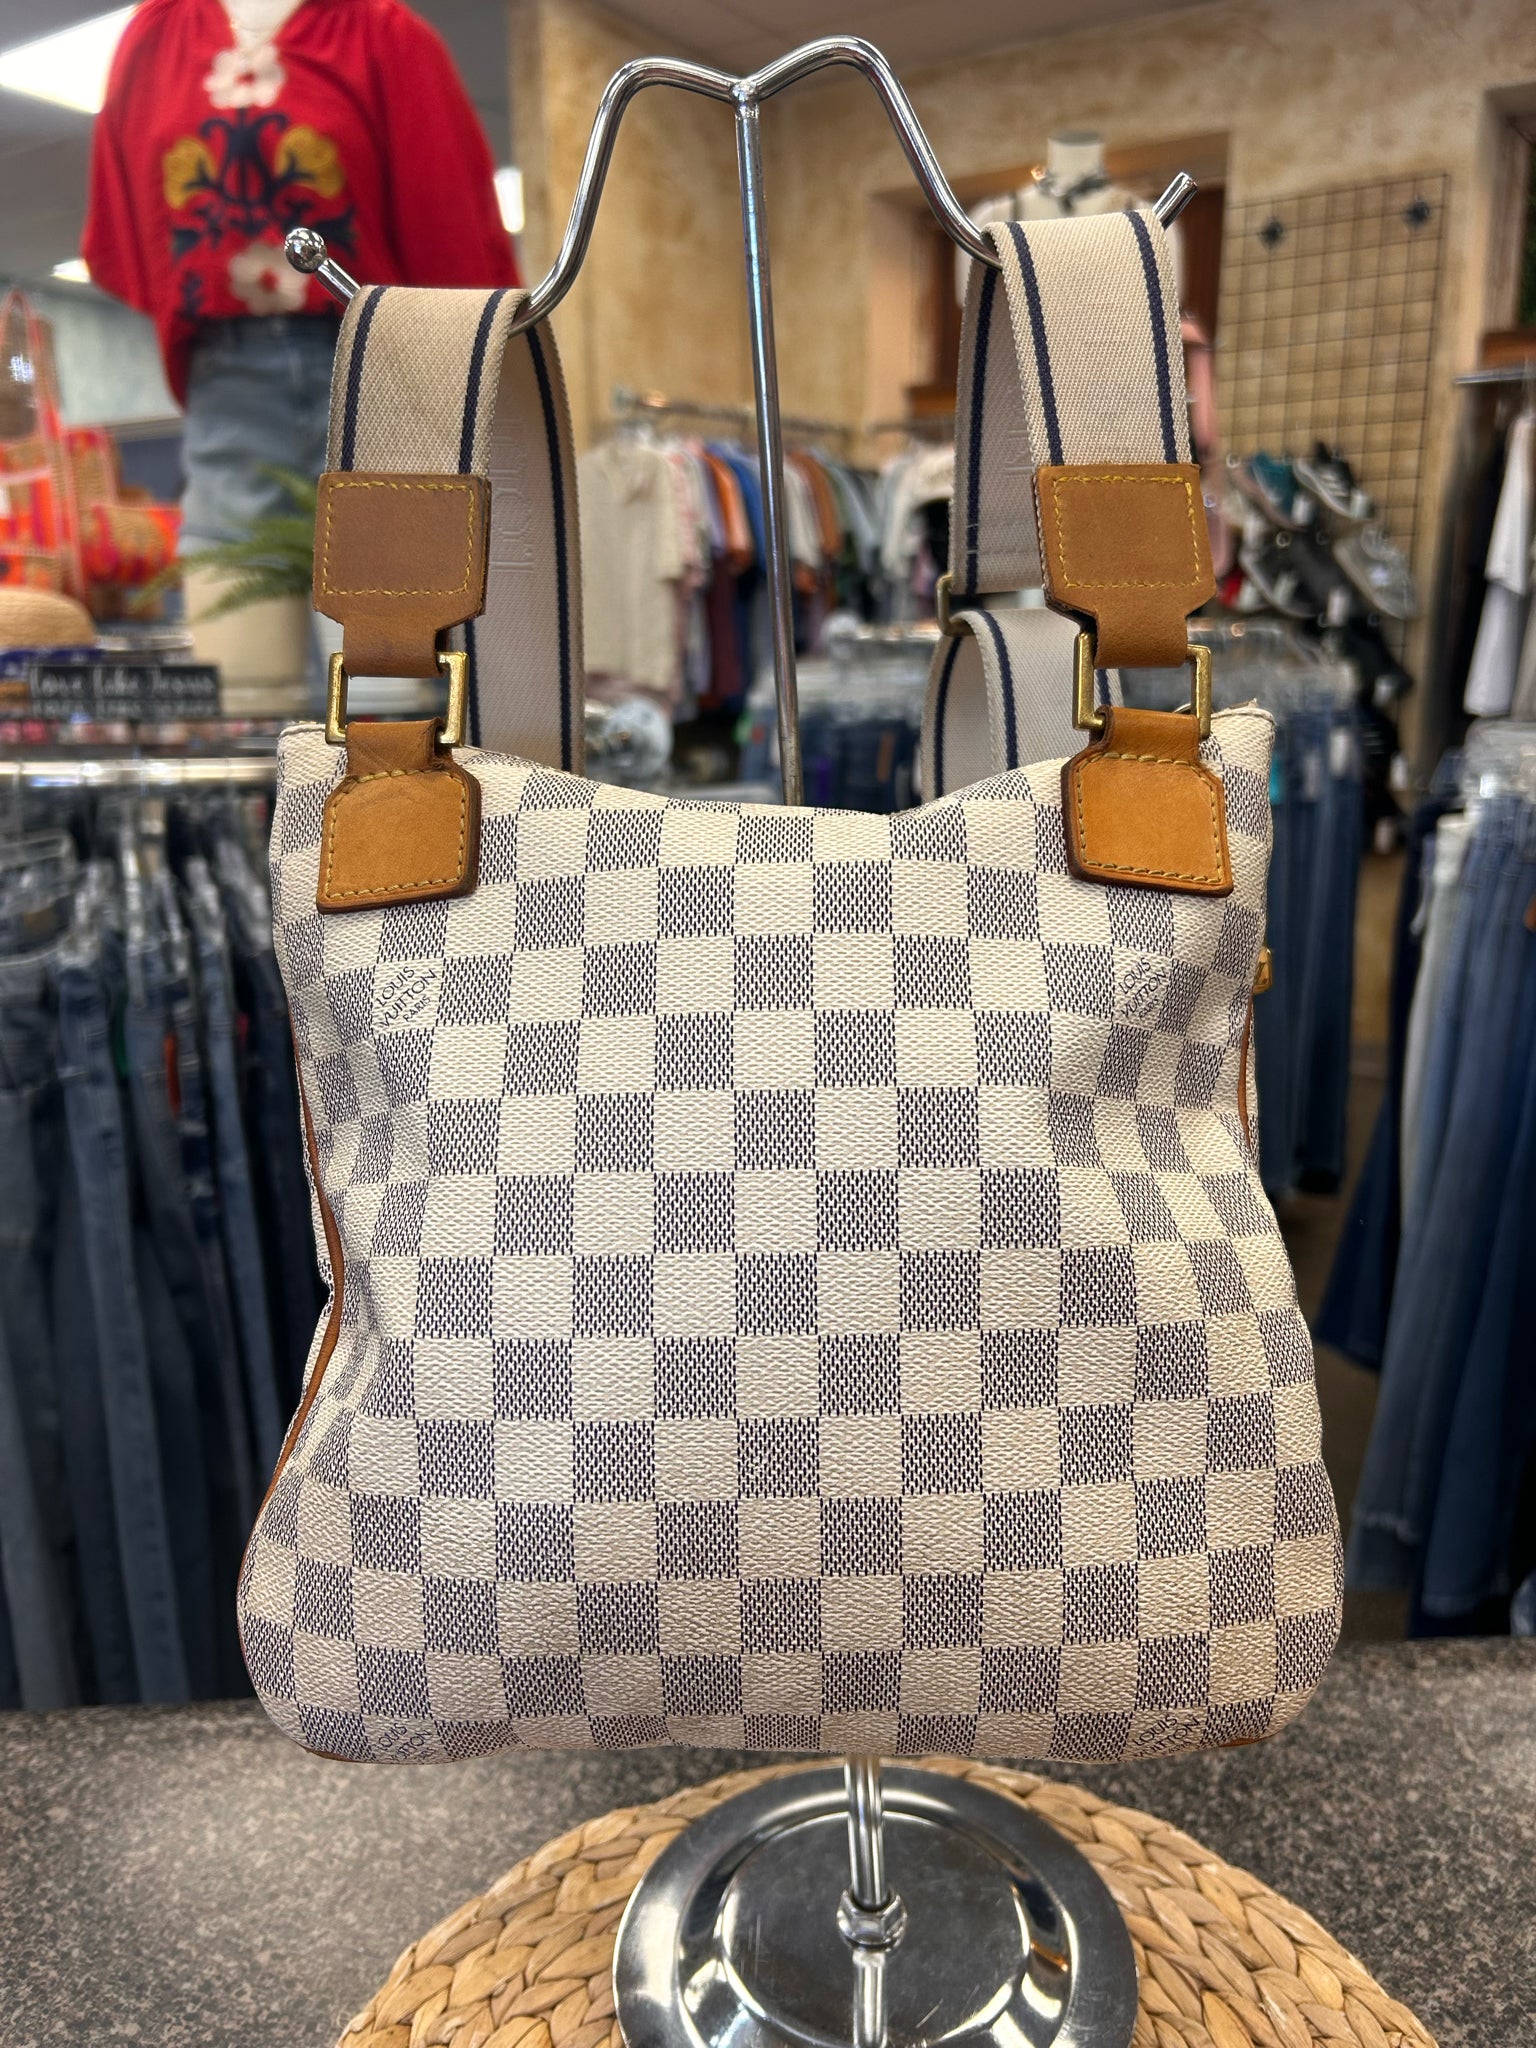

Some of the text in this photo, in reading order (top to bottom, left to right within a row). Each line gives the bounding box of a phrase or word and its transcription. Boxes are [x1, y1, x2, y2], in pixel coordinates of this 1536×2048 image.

[376, 966, 415, 1007] LOUIS
[1118, 957, 1151, 995] LOUIS
[1121, 967, 1167, 1019] VUITTON
[380, 969, 437, 1027] VUITTON
[403, 995, 430, 1022] PARIS
[1132, 1715, 1178, 1746] LOUIS
